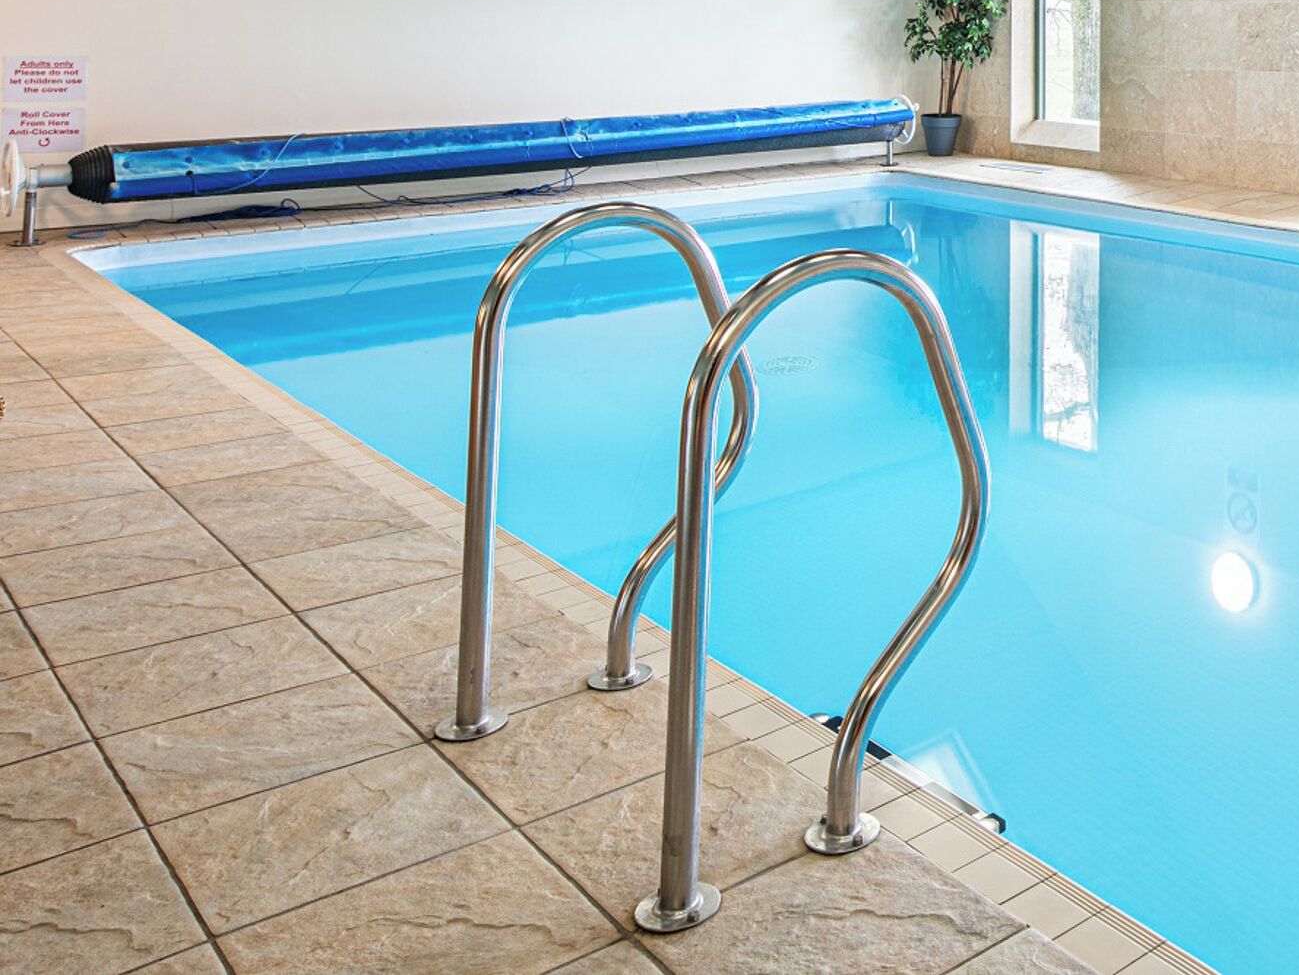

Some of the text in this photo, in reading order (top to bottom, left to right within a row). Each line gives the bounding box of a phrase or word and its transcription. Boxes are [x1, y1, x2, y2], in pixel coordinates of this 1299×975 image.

[20, 60, 74, 68] Adults only
[8, 128, 80, 136] Anti-Clockwise
